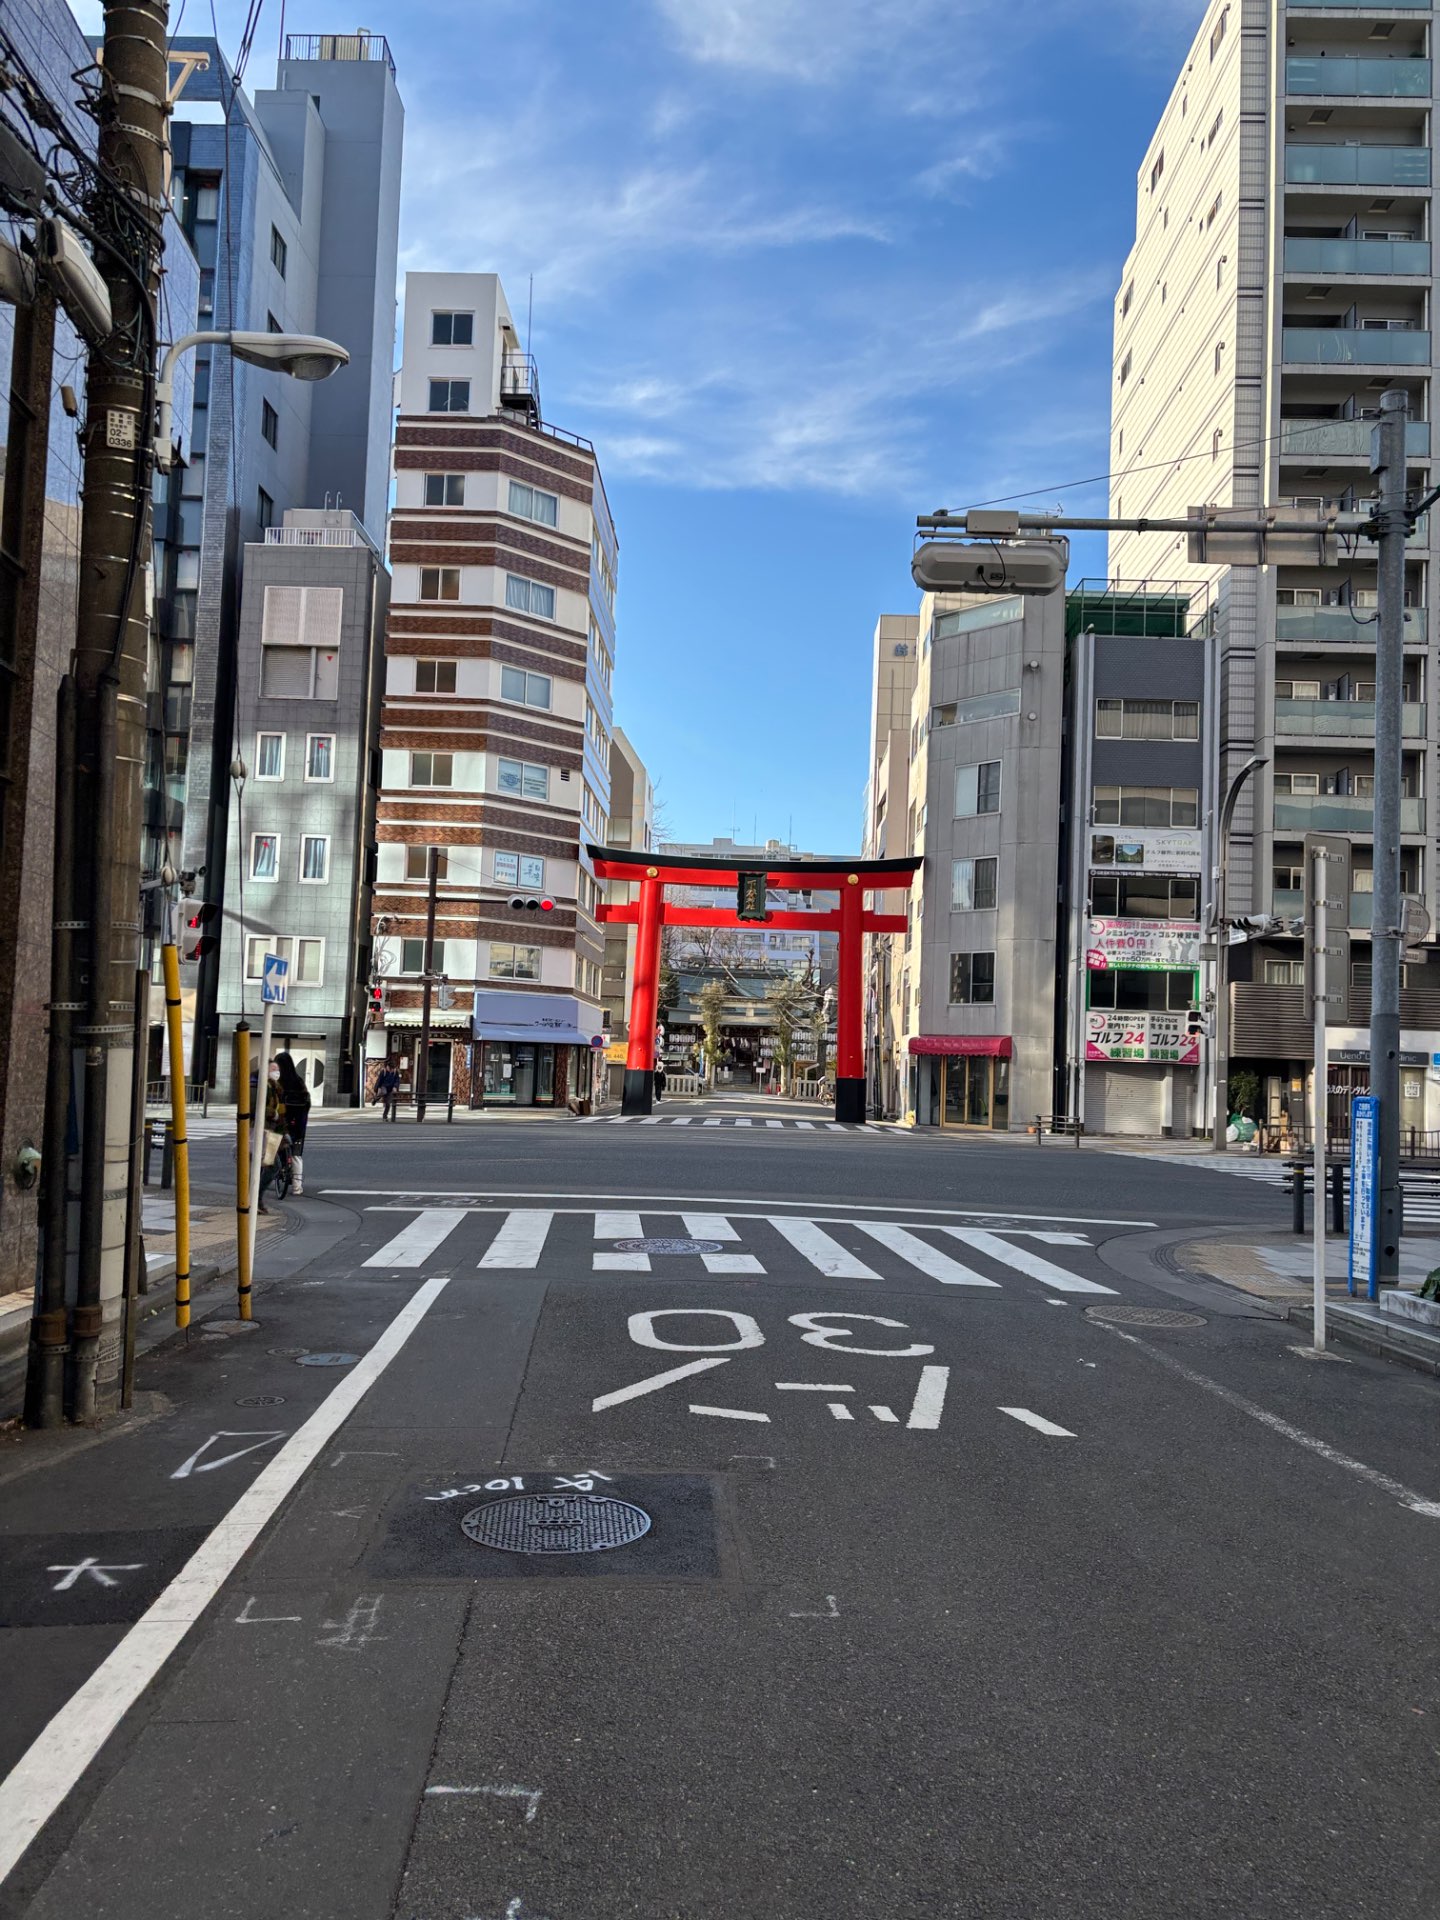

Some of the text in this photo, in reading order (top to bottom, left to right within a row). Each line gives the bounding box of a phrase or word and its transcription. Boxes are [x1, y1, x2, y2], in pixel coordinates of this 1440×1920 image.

[109, 437, 132, 448] 0336
[1107, 1014, 1146, 1022] 24時間OPEN
[1088, 1031, 1145, 1044] ゴルフ24
[1150, 1033, 1197, 1047] ゴルフ24
[1110, 1047, 1145, 1059] 練習場
[1150, 1049, 1179, 1060] 練習場
[1339, 1051, 1362, 1060] Ueno
[627, 1308, 936, 1358] 30
